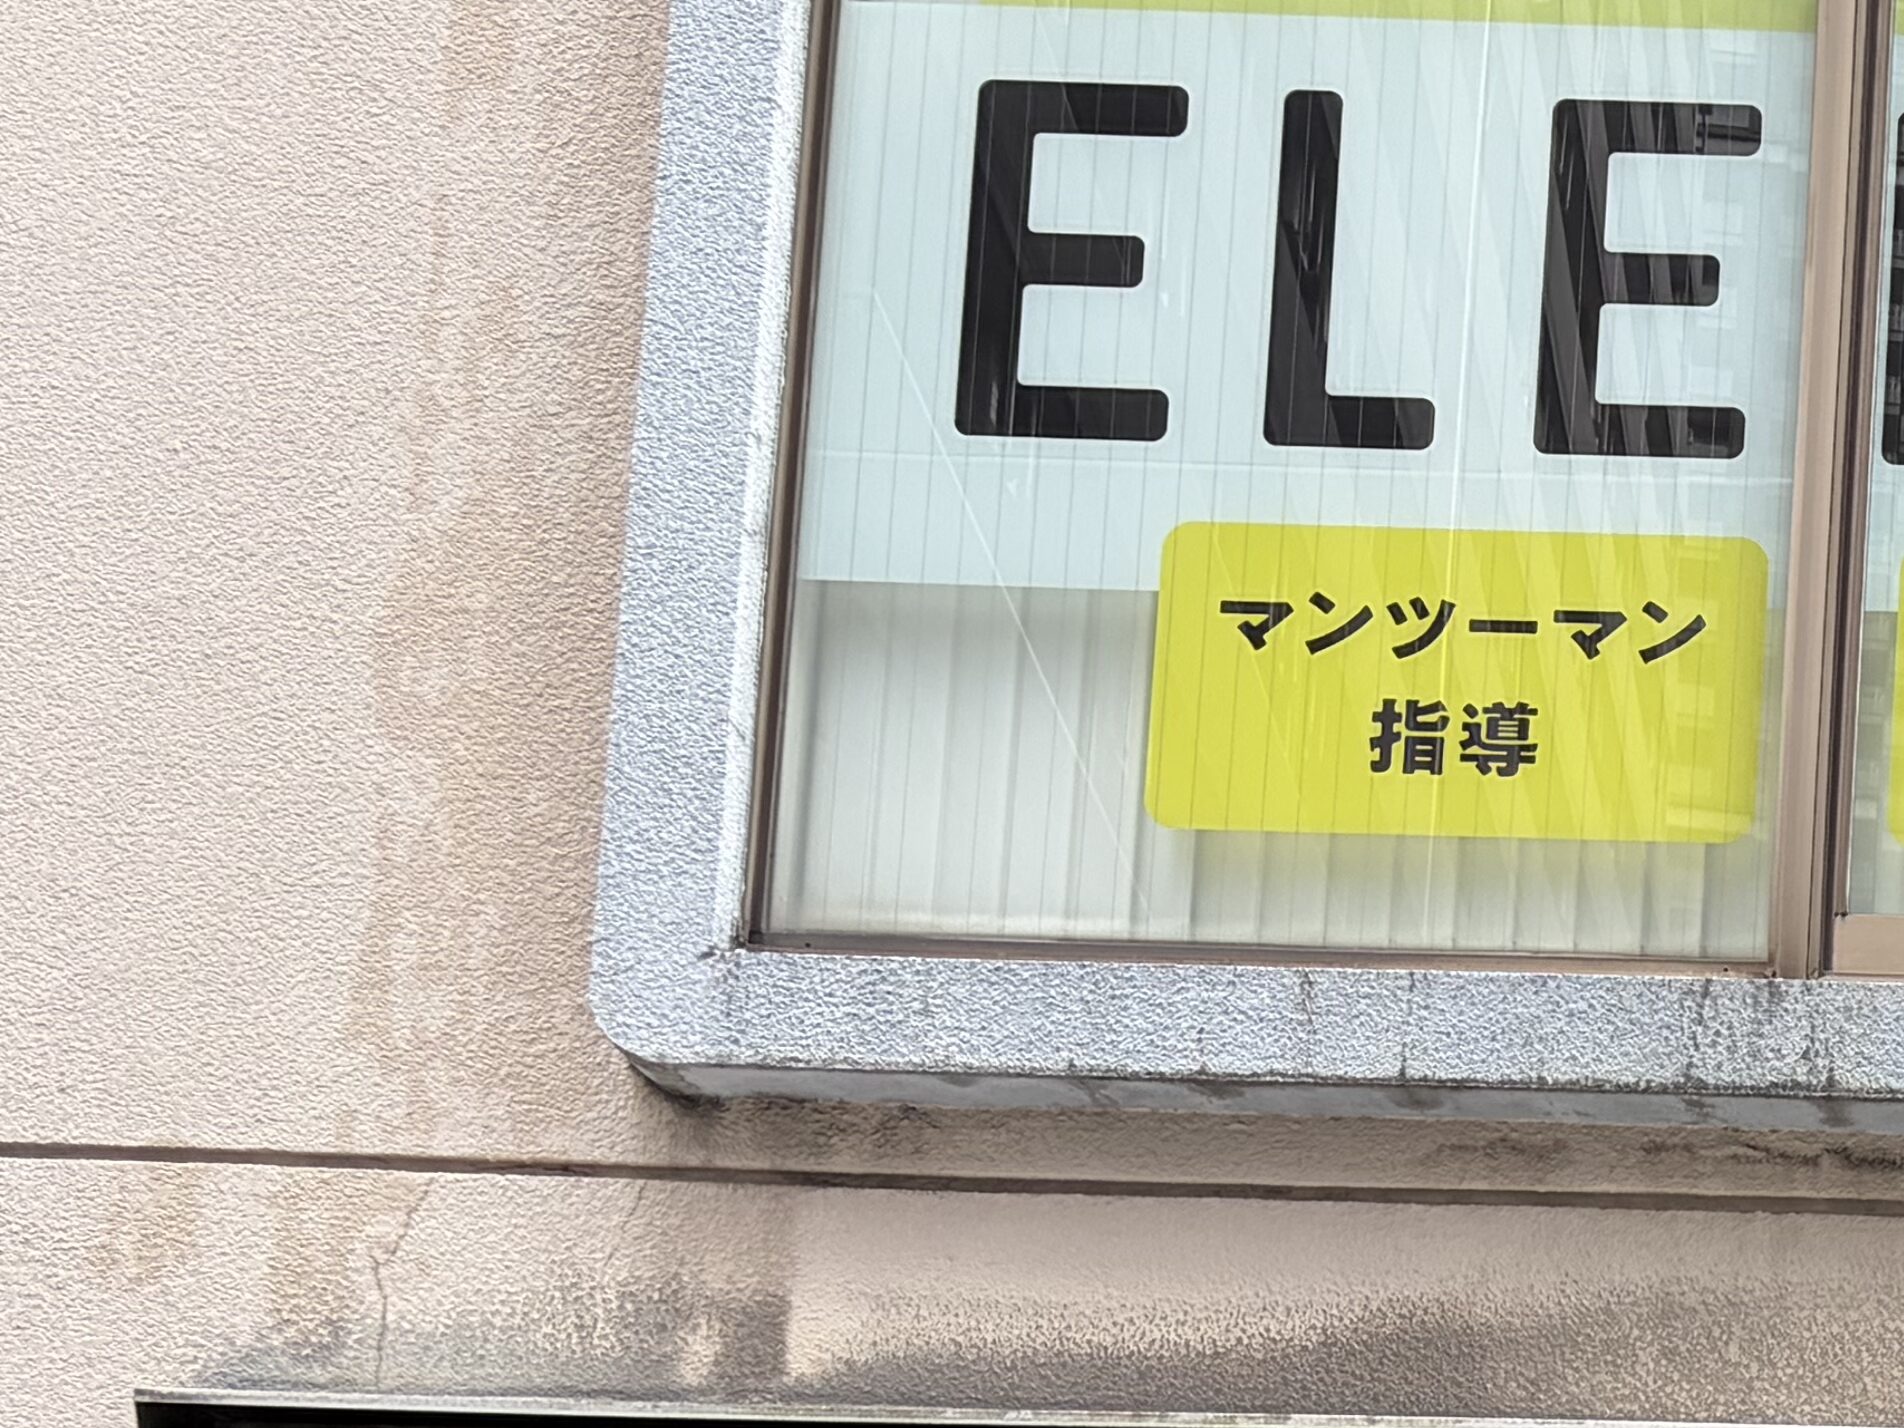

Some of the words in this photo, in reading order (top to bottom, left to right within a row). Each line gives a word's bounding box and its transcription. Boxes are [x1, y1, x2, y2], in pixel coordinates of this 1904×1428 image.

[1217, 590, 1707, 664] マンツーマン
[1368, 699, 1541, 779] 指導
